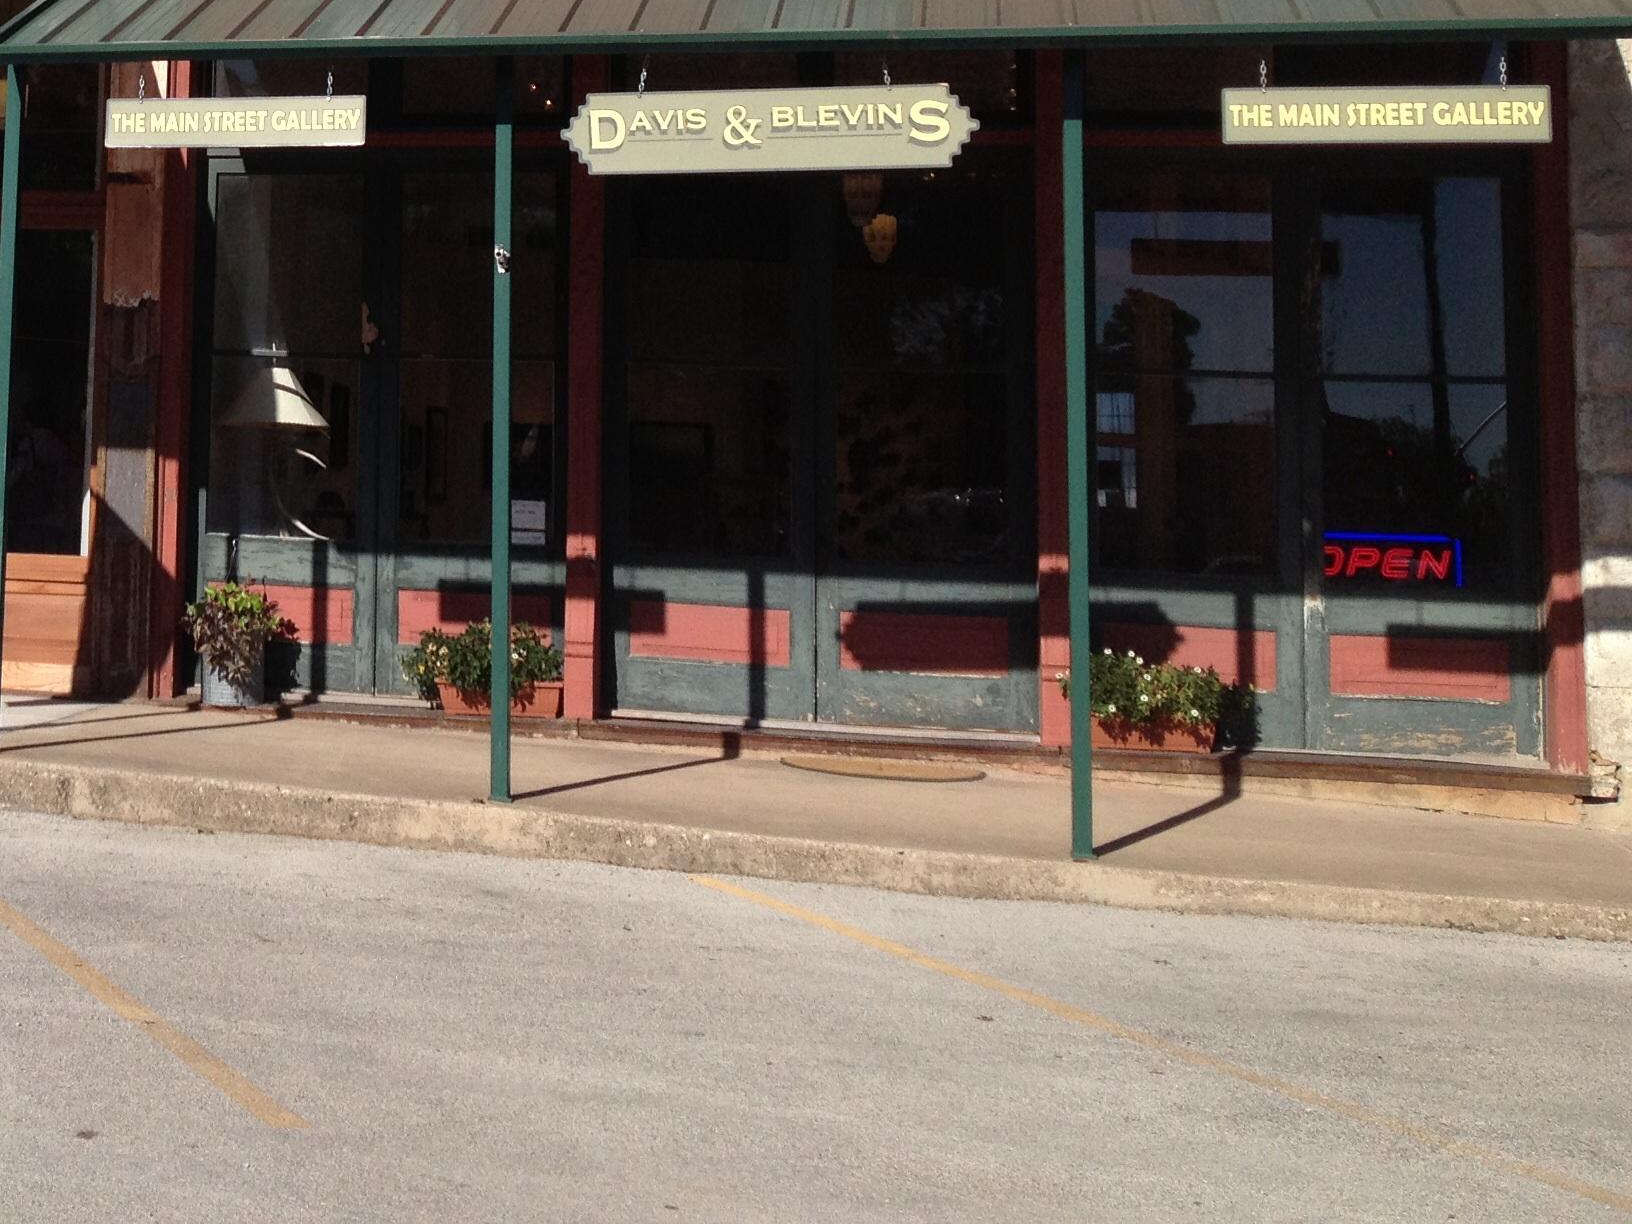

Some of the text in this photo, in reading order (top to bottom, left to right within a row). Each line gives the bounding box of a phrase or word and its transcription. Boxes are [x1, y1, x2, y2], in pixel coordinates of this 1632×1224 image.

[111, 107, 361, 133] THE MAIN STREET GALLERY
[721, 104, 764, 149] &
[1229, 101, 1545, 128] THE MAIN STREET GALLERY
[1323, 545, 1452, 580] OPEN
